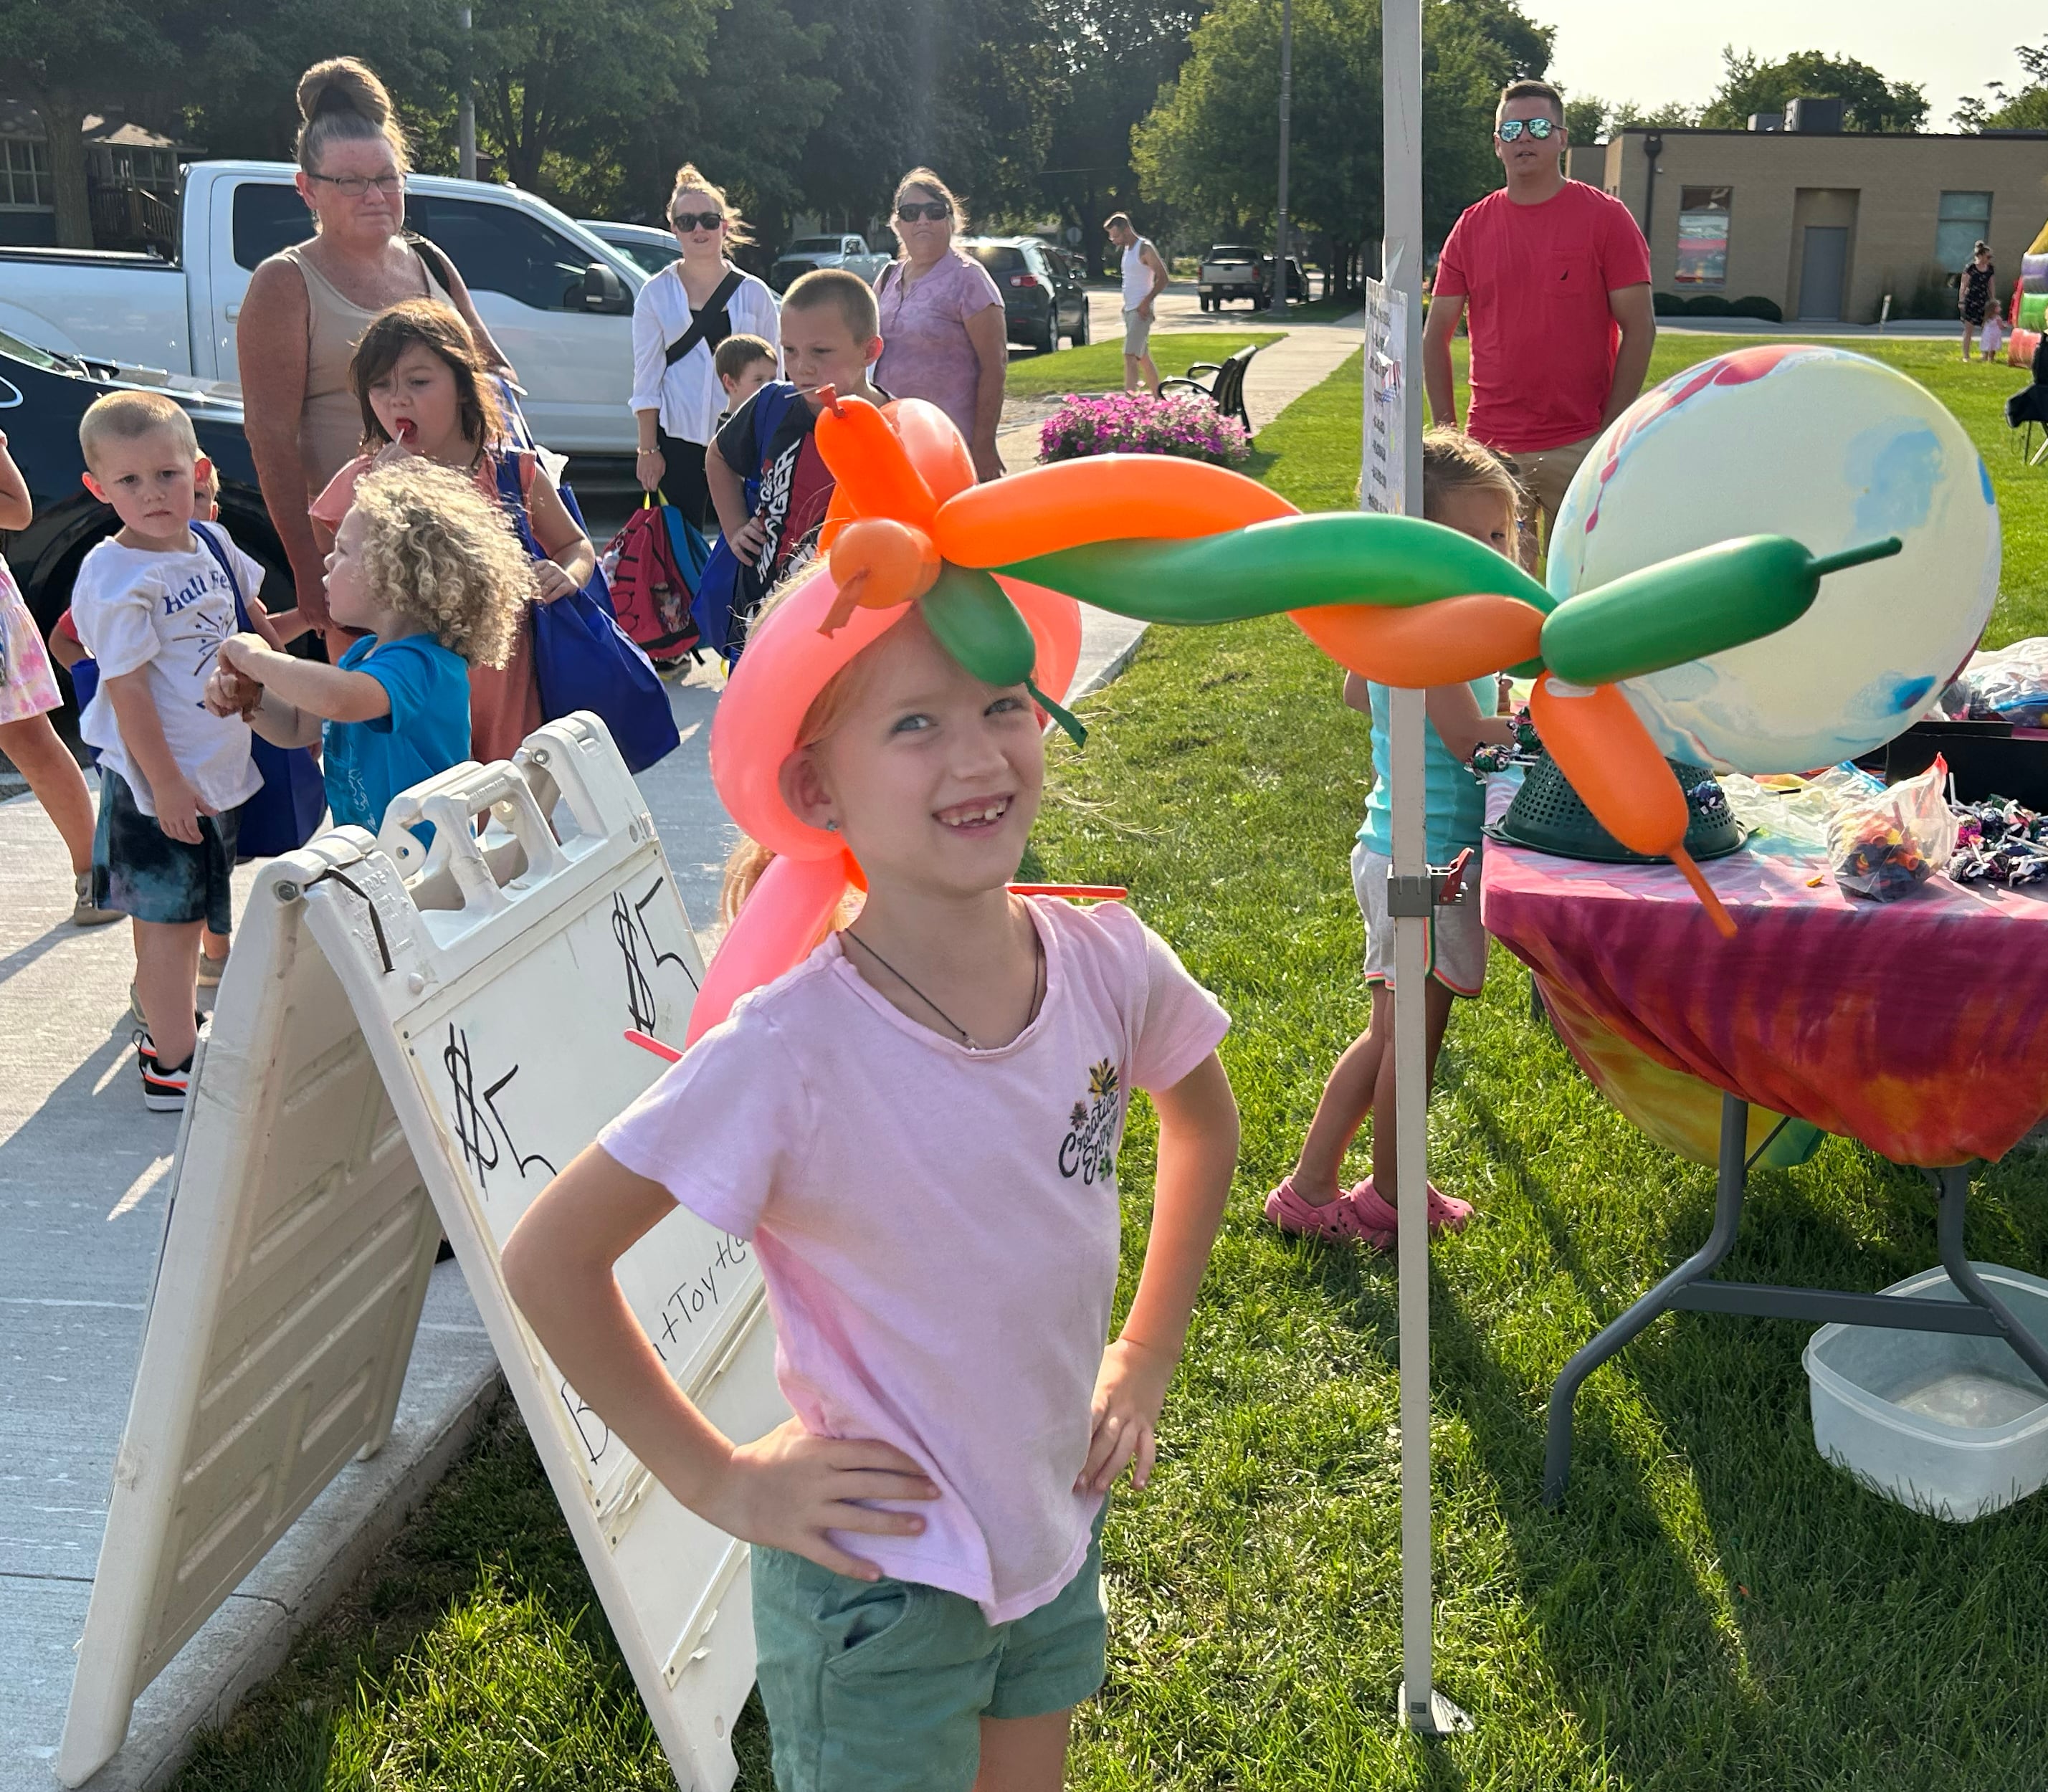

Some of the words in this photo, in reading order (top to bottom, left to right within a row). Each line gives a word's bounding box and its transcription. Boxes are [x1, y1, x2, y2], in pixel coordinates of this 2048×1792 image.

[162, 574, 209, 616] Hall
[611, 876, 700, 1038] $5
[444, 1021, 558, 1202] $5
[1058, 1091, 1119, 1178] Creative
